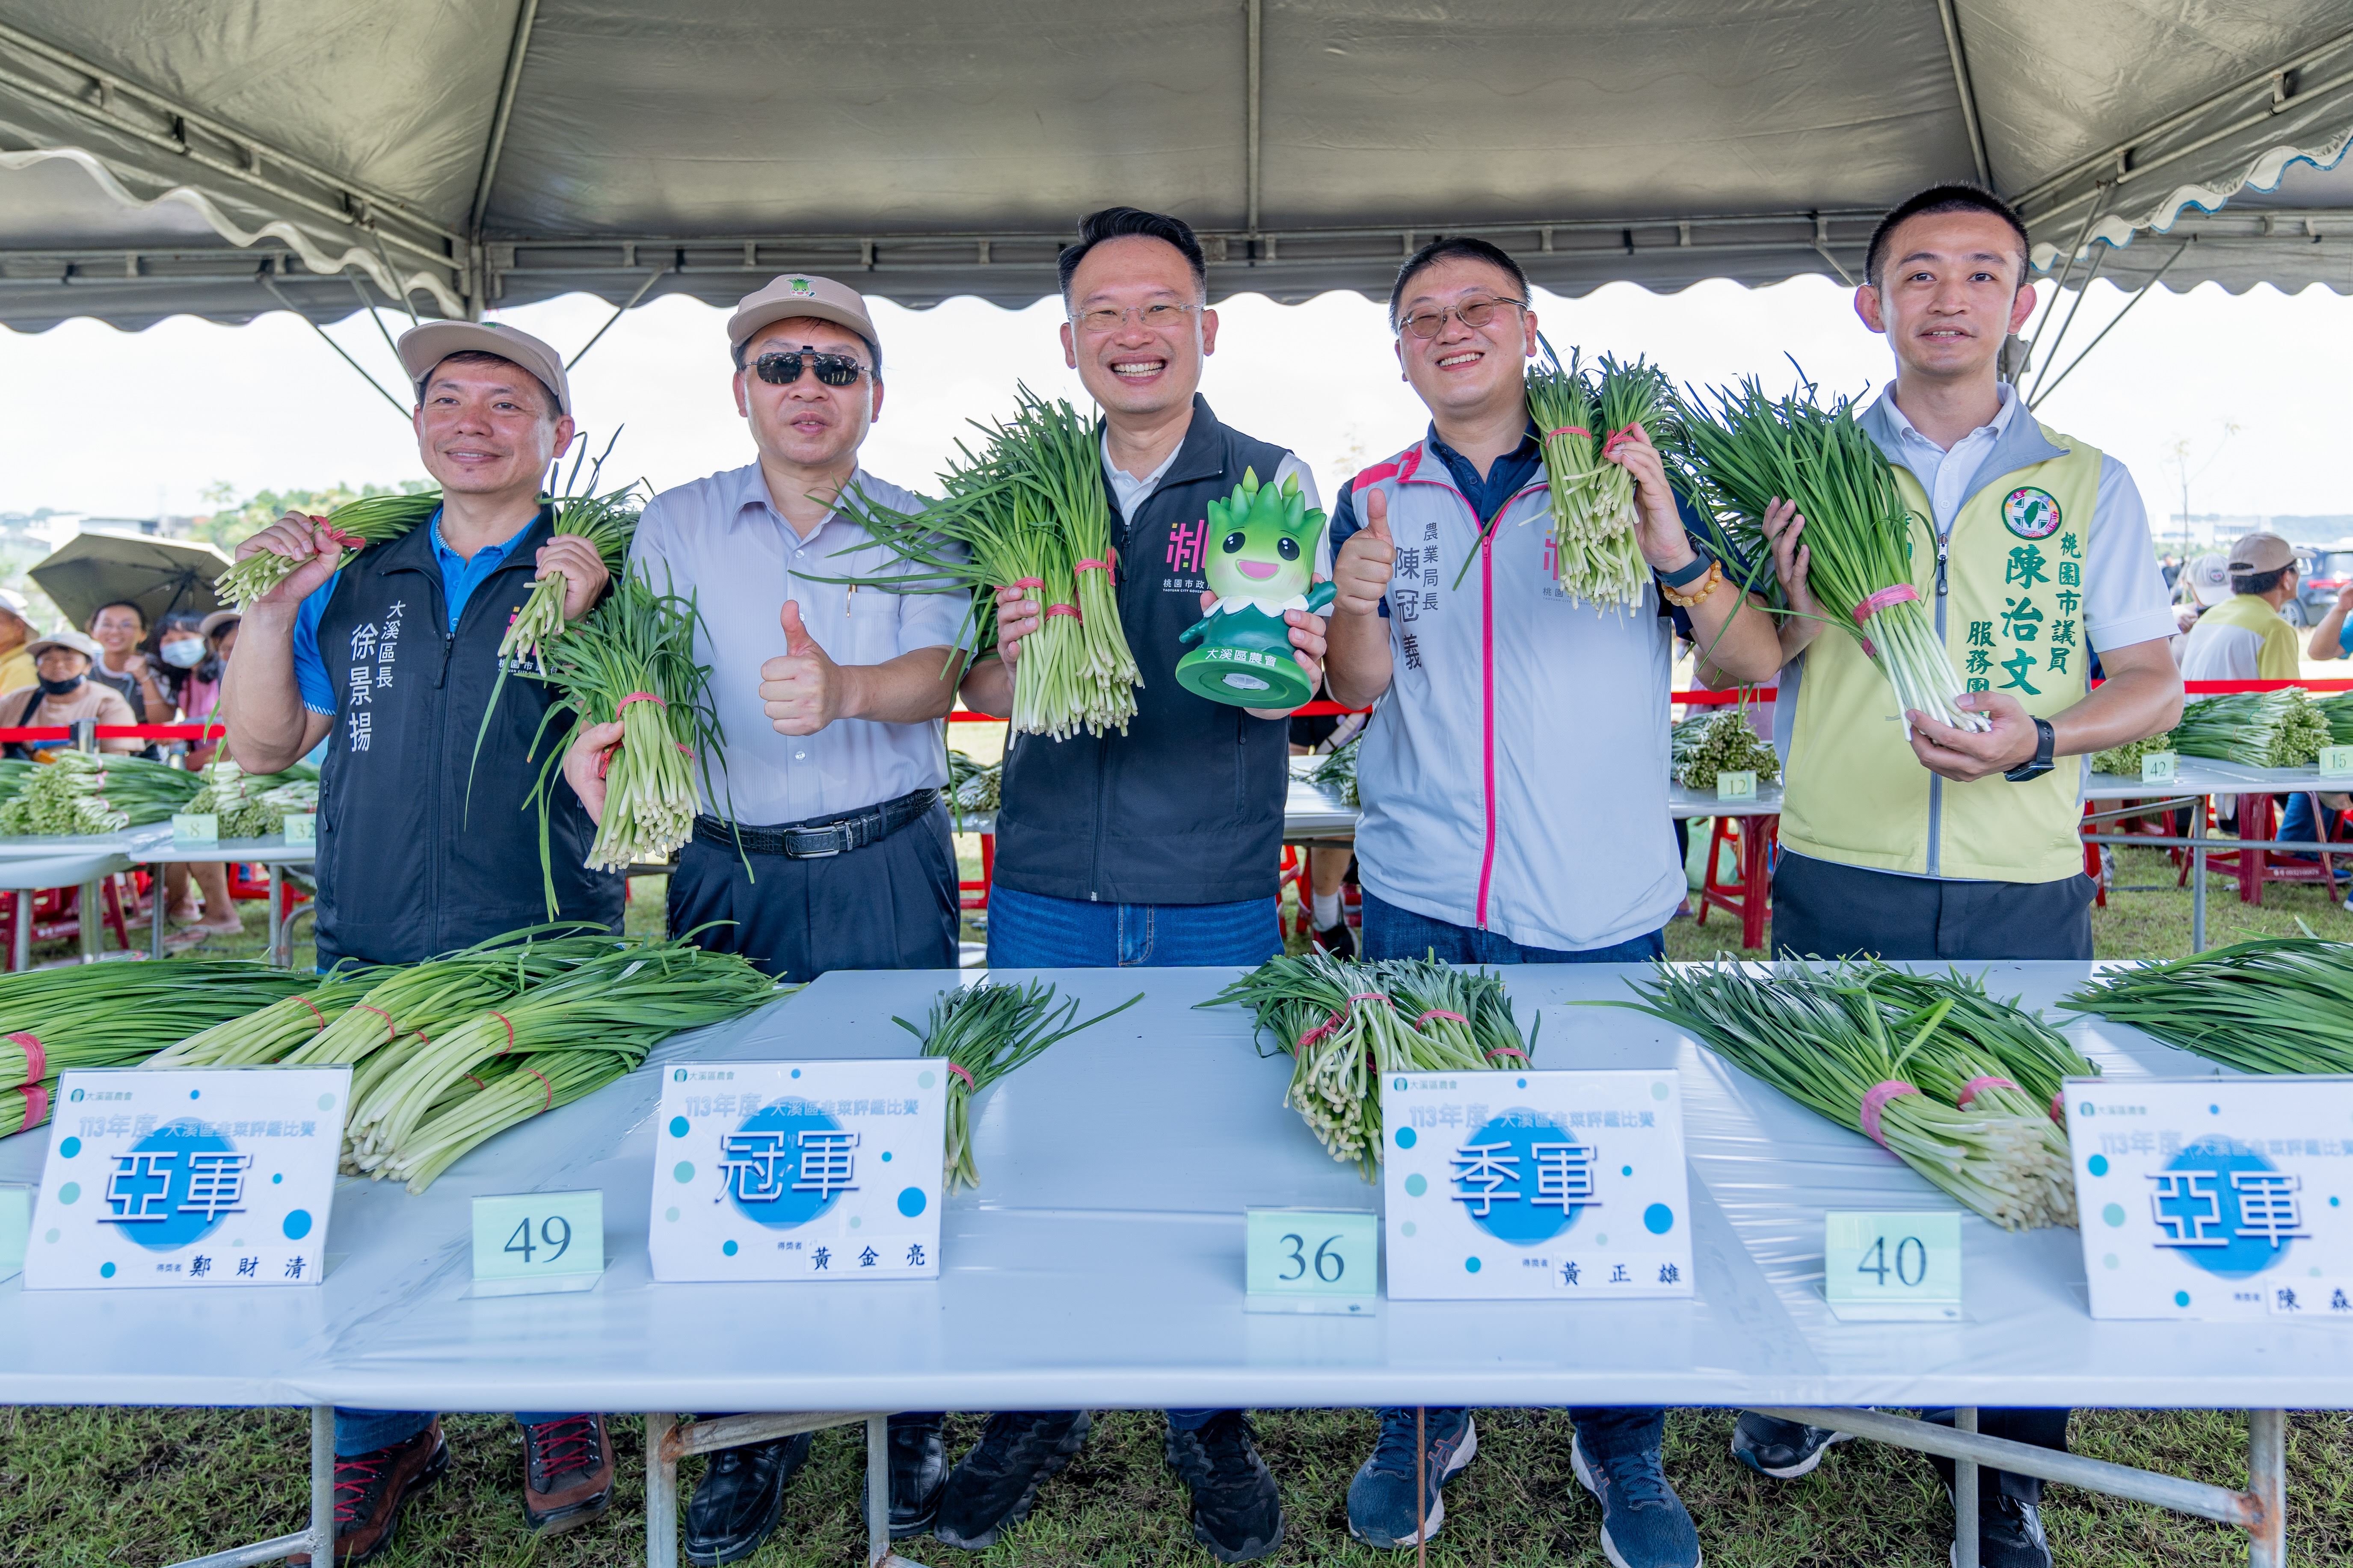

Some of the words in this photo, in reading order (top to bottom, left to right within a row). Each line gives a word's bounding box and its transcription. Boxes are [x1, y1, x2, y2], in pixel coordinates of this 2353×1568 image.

[1422, 522, 1439, 611] 農業局長
[1394, 546, 1422, 671] 陳冠義
[1997, 544, 2051, 695] 陳治文
[2047, 532, 2082, 675] 桃園市議員
[376, 600, 406, 689] 大溪區長
[498, 658, 558, 674] 桃園市府
[1205, 648, 1277, 668] 大溪區農會
[1965, 621, 1997, 715] 服務團
[349, 623, 378, 752] 徐景揚
[2150, 761, 2167, 777] 42
[2332, 753, 2347, 769] 15
[1728, 778, 1747, 795] 12
[190, 822, 200, 838] 8
[86, 1092, 133, 1101] 大溪區農會
[689, 1071, 735, 1081] 大溪區農會
[1410, 1080, 1457, 1090] 大溪區農會
[79, 1113, 159, 1138] 113年度
[685, 1092, 762, 1118] 113年度
[1409, 1103, 1490, 1129] 113年度
[97, 1151, 253, 1223] 亞軍
[714, 1130, 860, 1204] 冠軍
[1449, 1140, 1603, 1218] 季軍
[2145, 1169, 2313, 1249] 亞軍
[504, 1215, 572, 1263] 49
[1278, 1233, 1345, 1282] 36
[1857, 1235, 1928, 1287] 40
